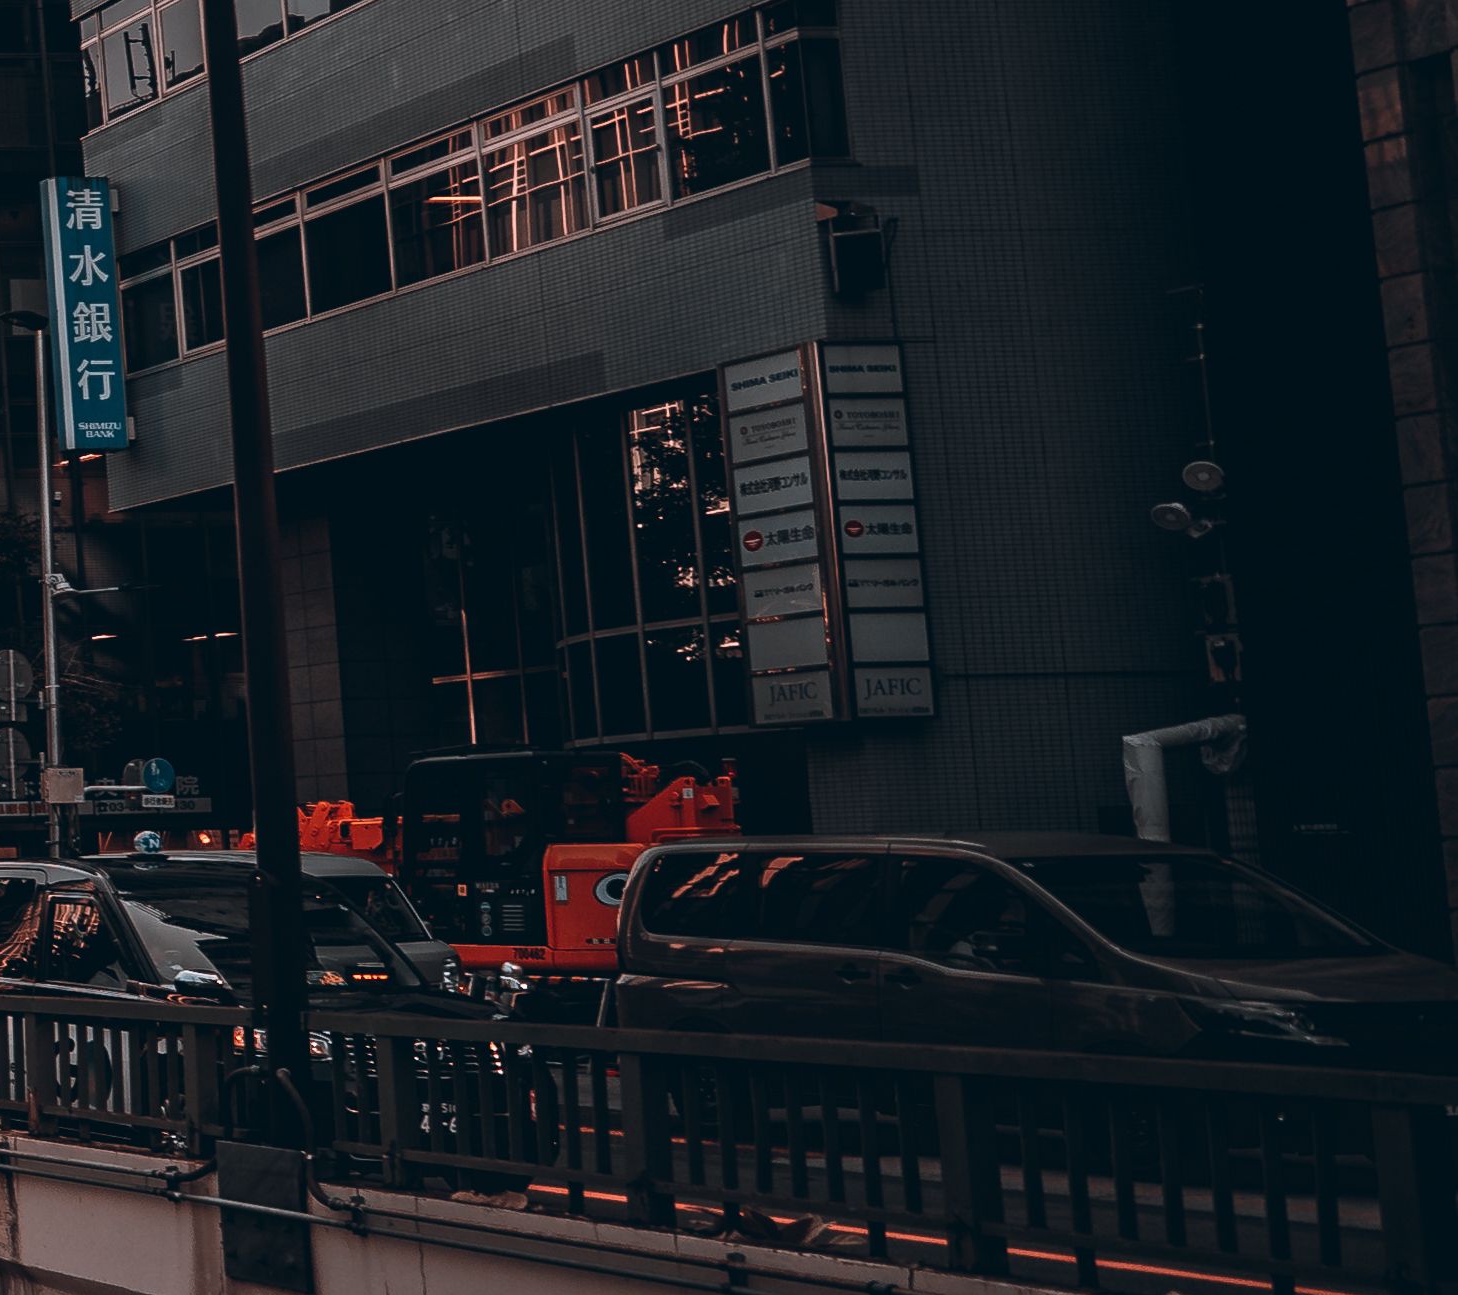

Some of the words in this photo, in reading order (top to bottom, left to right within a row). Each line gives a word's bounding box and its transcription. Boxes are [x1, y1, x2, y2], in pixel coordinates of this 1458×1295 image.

[65, 189, 117, 402] 清水銀行
[829, 364, 865, 373] SHIMA
[866, 364, 897, 372] SEIKI
[731, 377, 767, 392] SHIMA
[768, 368, 799, 383] SEIKI
[77, 421, 122, 431] SHIMIZU
[85, 430, 115, 439] BANK
[764, 525, 814, 547] 太陽生命
[865, 522, 913, 536] 太陽生命
[769, 681, 818, 706] JAFIC
[864, 678, 923, 700] JAFIC
